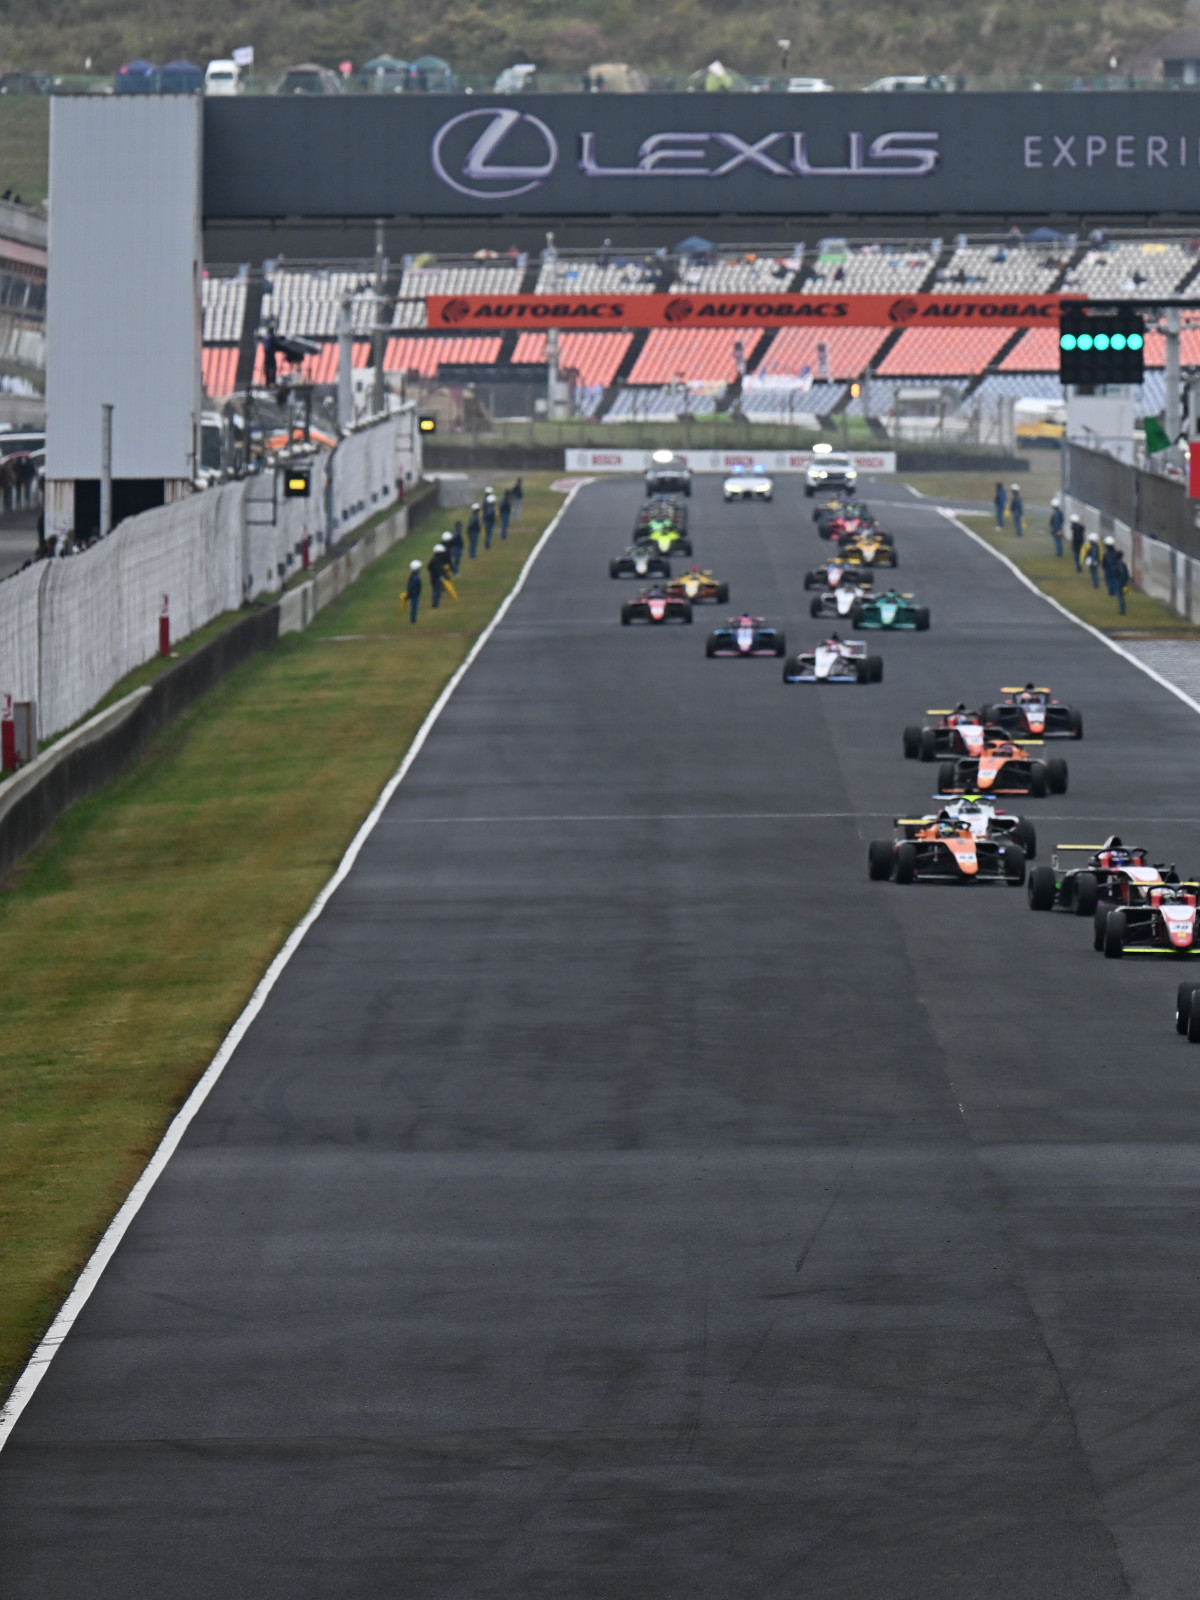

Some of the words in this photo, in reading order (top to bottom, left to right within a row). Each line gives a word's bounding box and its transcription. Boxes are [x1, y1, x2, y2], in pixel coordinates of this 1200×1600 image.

[577, 131, 940, 177] LEXUS
[473, 303, 624, 318] AUTOBACS
[696, 303, 849, 318] AUTOBACS
